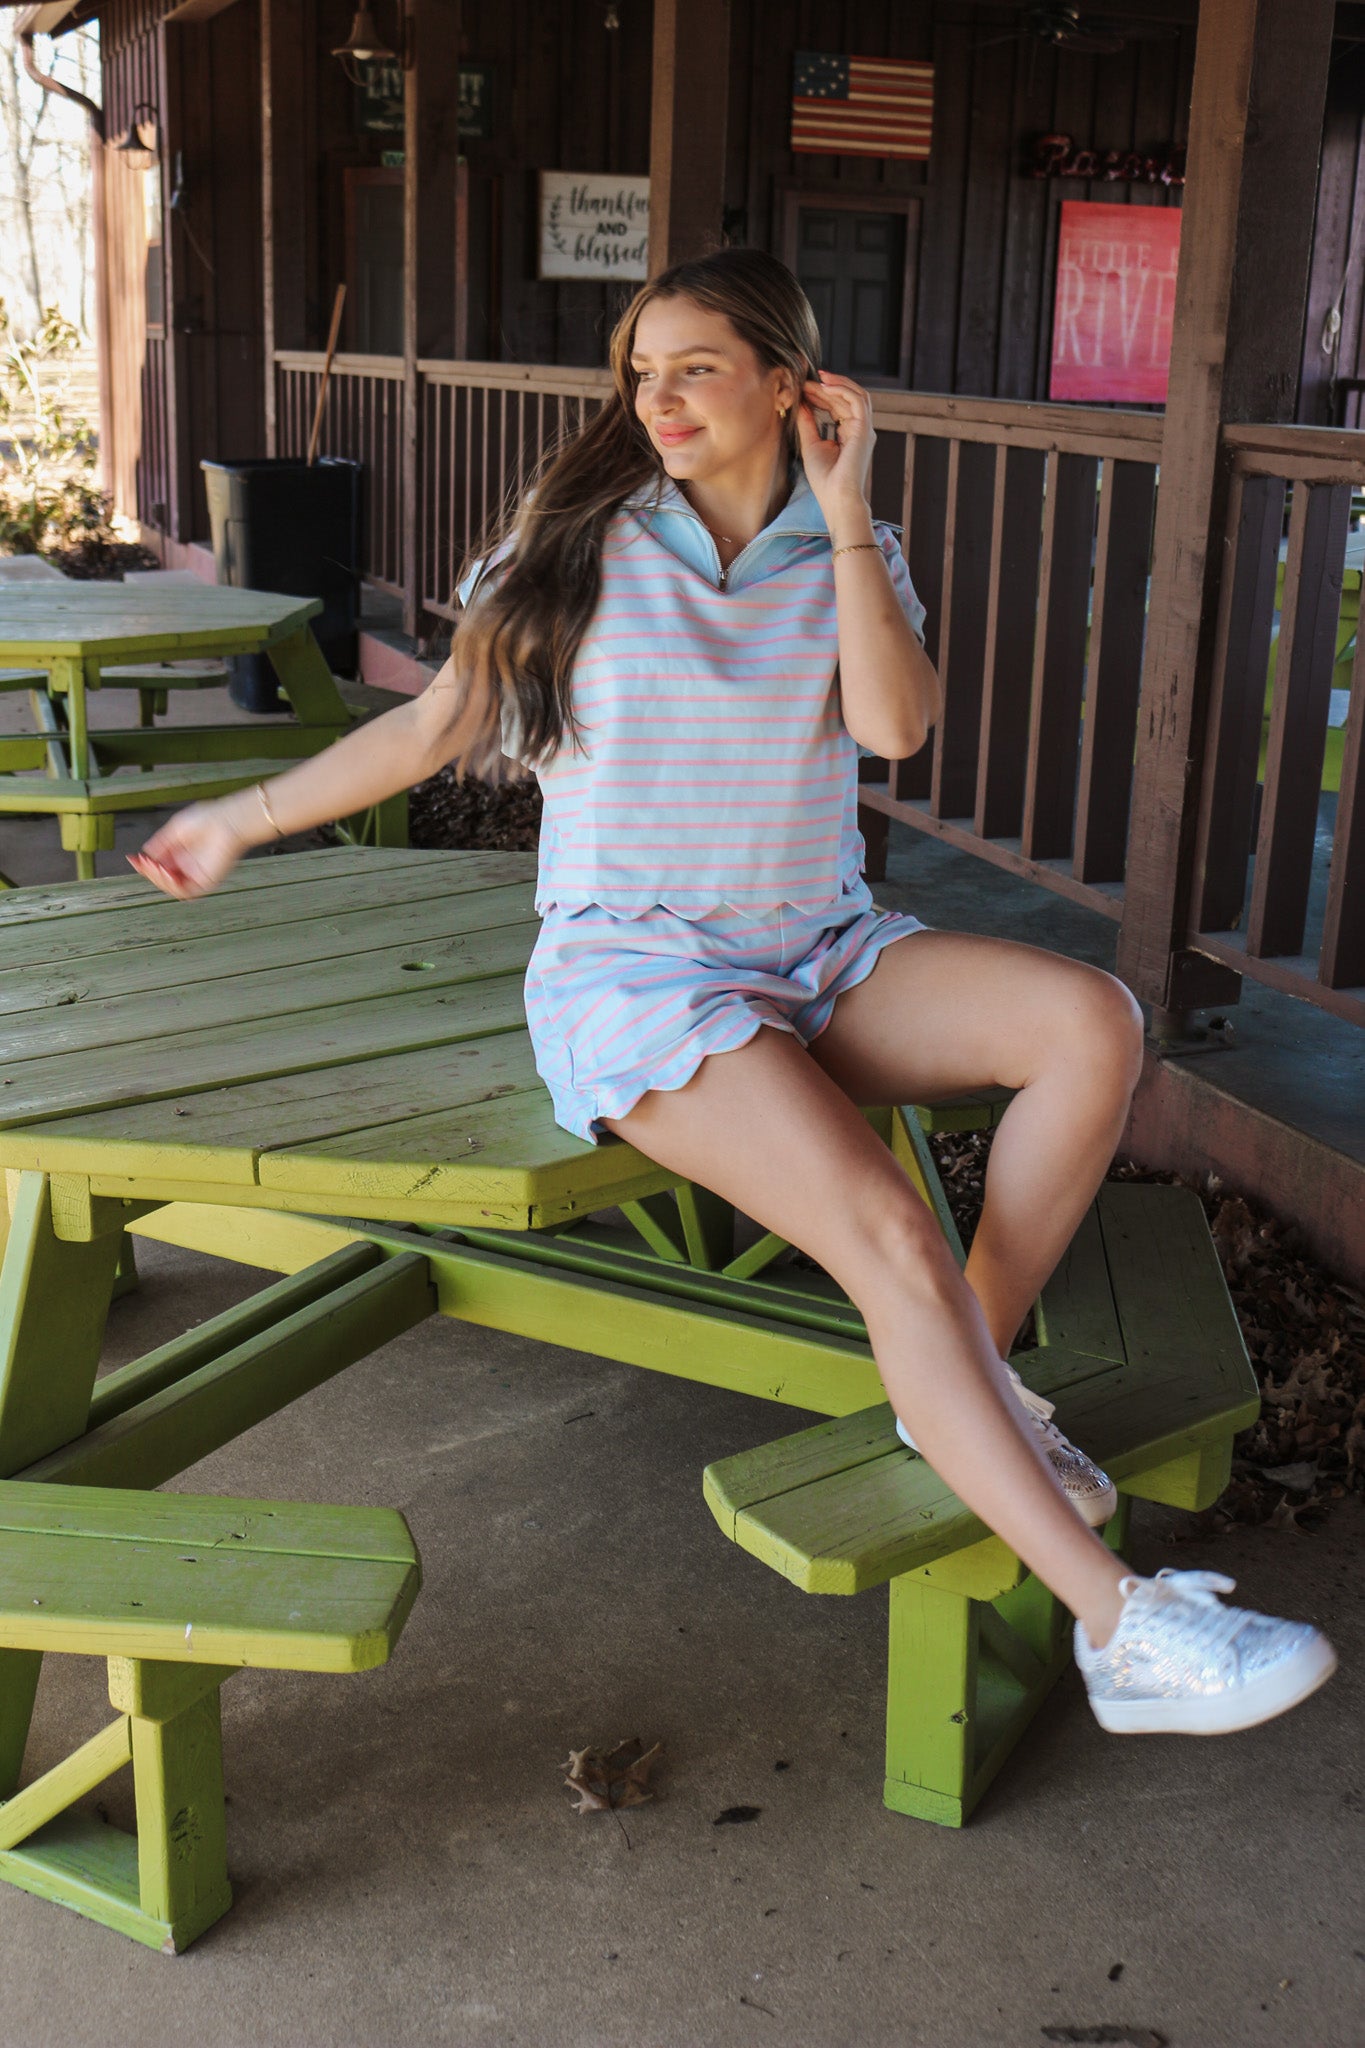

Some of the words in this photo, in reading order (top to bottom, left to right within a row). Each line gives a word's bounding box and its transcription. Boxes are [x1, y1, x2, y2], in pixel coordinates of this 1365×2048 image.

[570, 185, 649, 220] thankfu
[596, 222, 627, 236] AND
[574, 233, 647, 268] blessed
